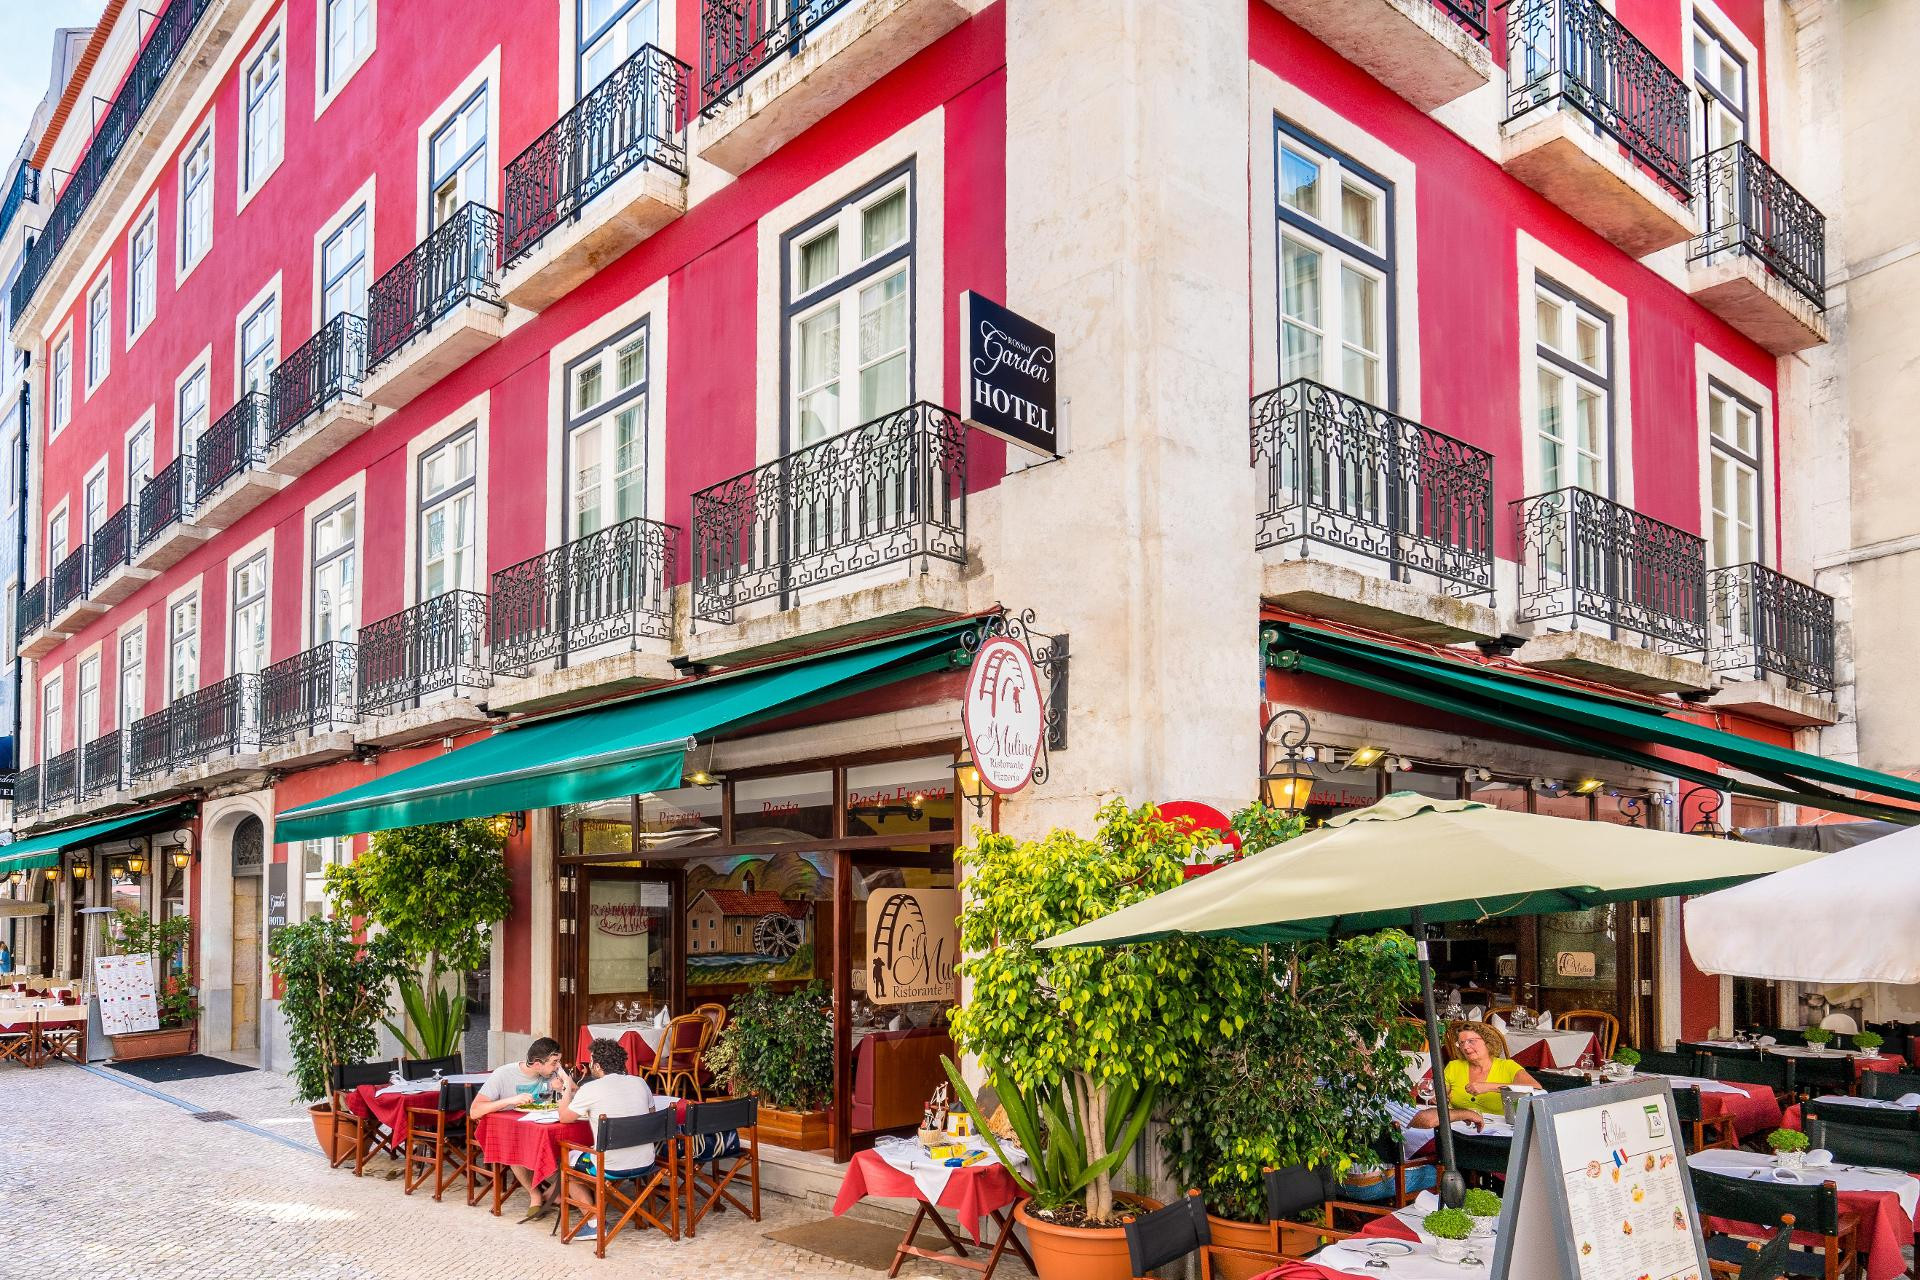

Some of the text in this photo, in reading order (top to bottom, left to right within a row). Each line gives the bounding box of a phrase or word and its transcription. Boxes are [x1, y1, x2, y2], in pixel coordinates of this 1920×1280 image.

[973, 320, 1054, 384] Garden
[1007, 336, 1031, 354] ROSSIO
[974, 378, 1055, 435] HOTEL
[975, 722, 1035, 758] Mulino
[849, 785, 947, 808] Pasta Fresca
[1307, 789, 1337, 806] asta
[762, 800, 800, 817] Pasta
[893, 984, 942, 998] Ristorante
